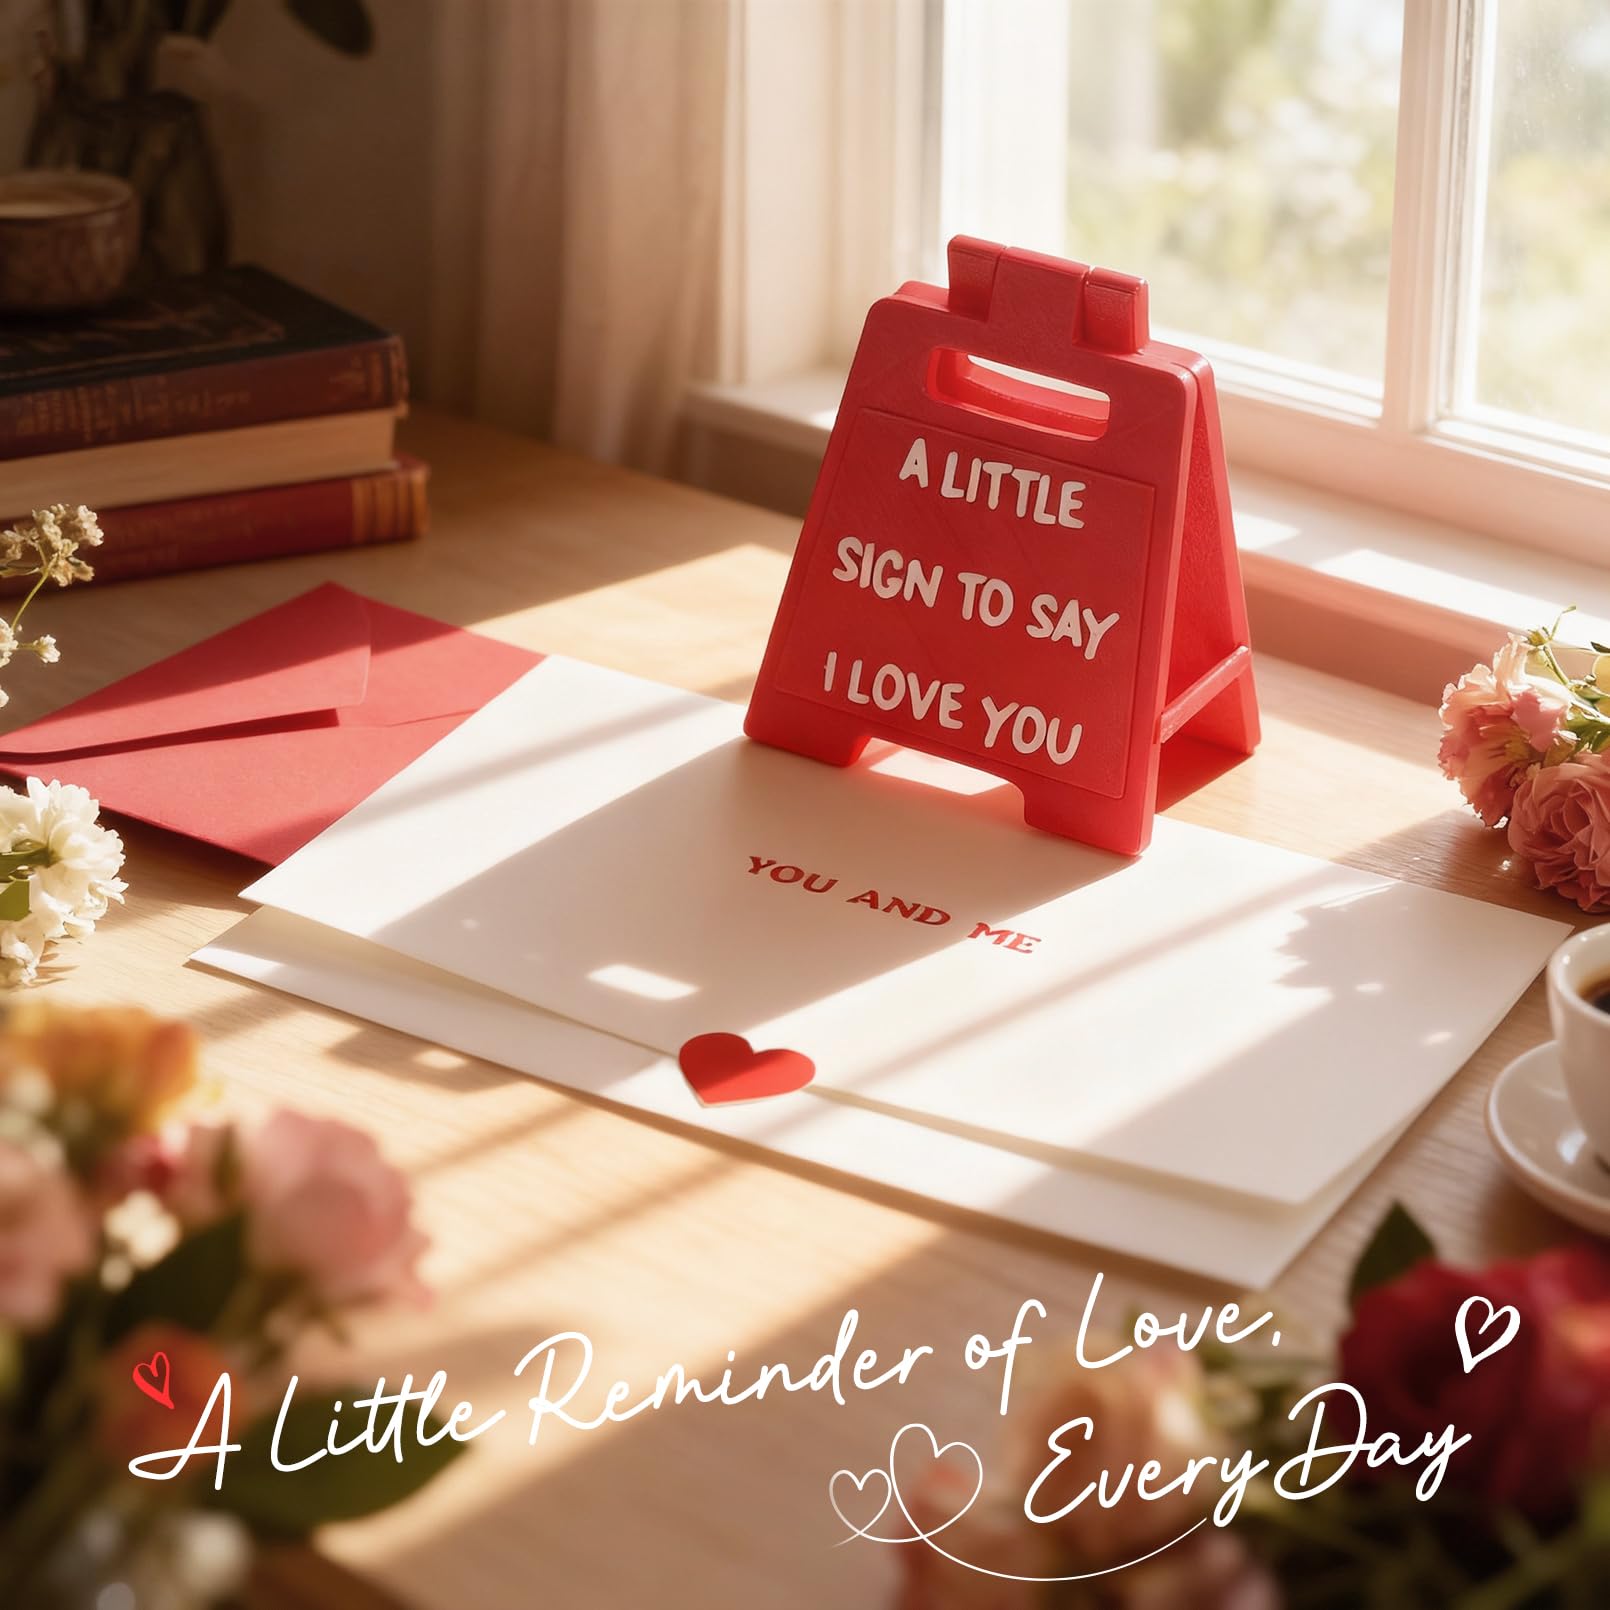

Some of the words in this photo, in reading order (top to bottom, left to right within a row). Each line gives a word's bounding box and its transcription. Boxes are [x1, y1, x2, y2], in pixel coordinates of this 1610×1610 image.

[899, 438, 928, 488] A
[941, 451, 1087, 529] LITTLE
[832, 536, 944, 608] SIGN
[957, 572, 1013, 627] TO
[1026, 593, 1120, 660] SAY
[823, 651, 837, 692] I
[847, 659, 965, 729] LOVE
[980, 696, 1083, 765] YOU
[748, 856, 838, 893] YOU
[846, 890, 951, 925] AND
[967, 922, 1042, 954] ME
